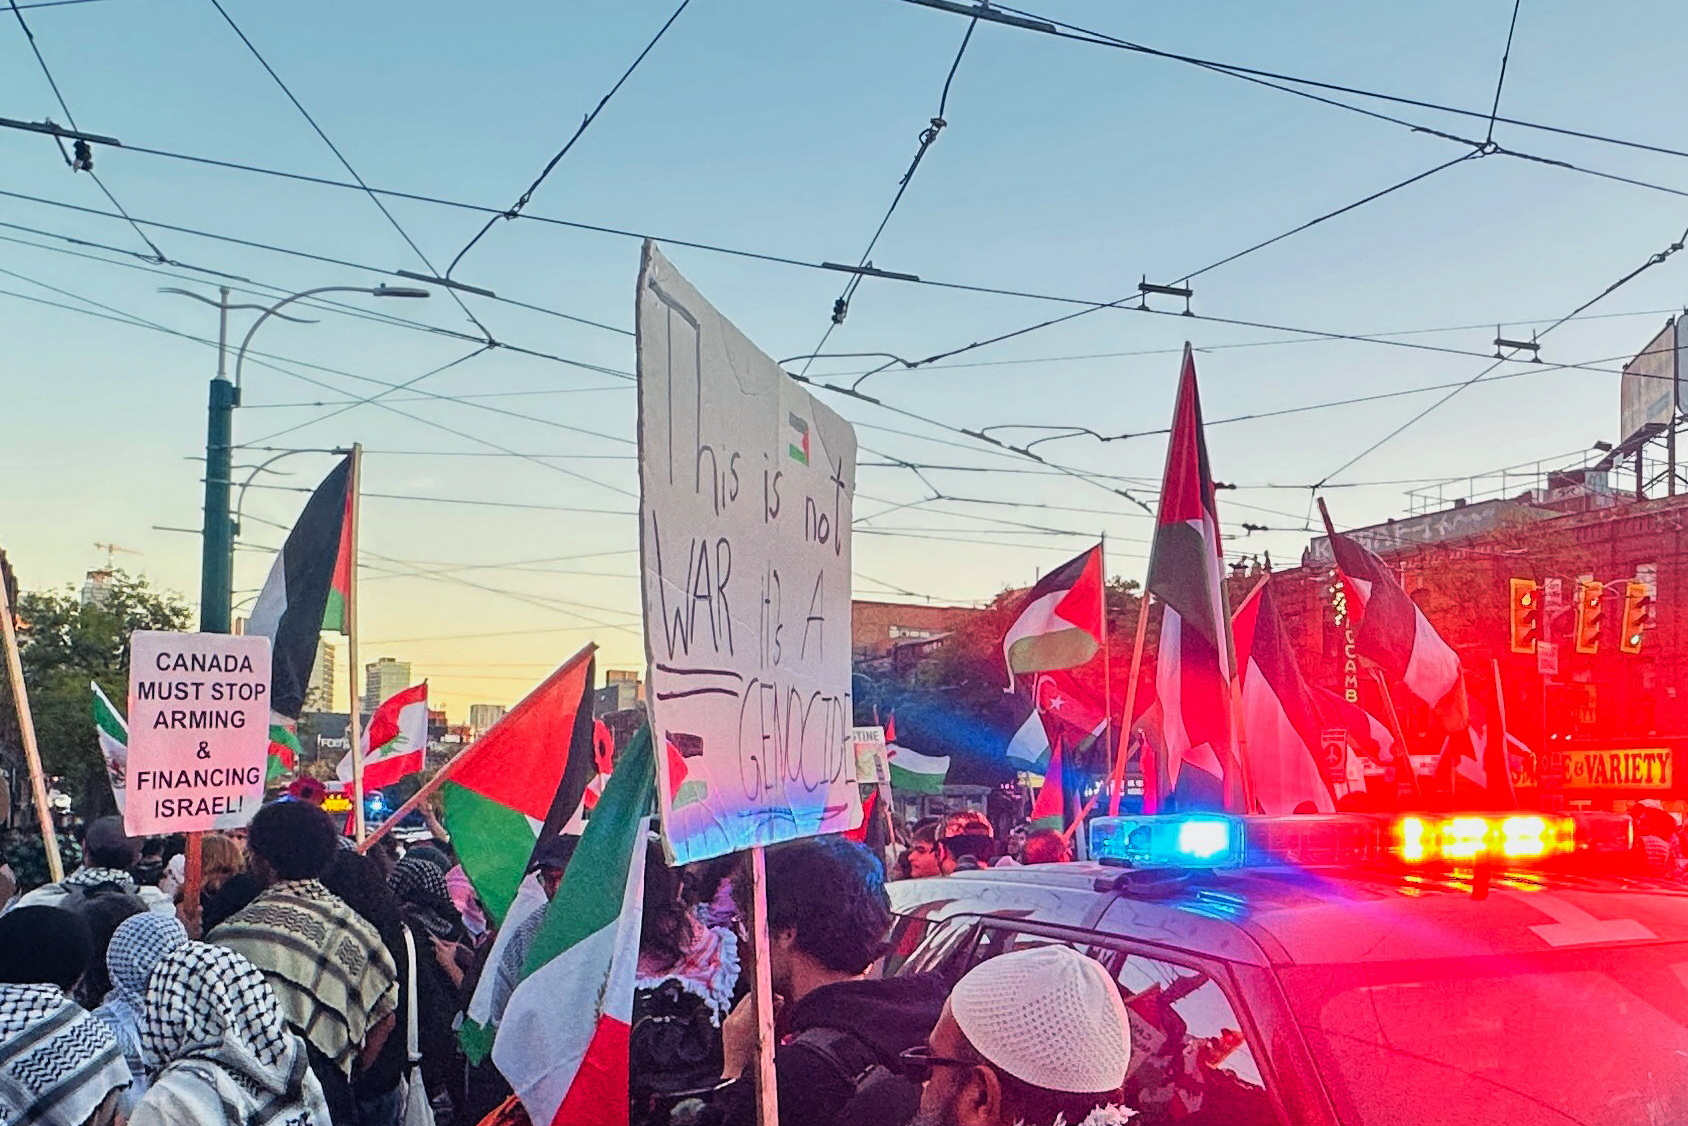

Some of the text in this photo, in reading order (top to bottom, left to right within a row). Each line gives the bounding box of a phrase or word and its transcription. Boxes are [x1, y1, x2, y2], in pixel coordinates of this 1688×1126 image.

[764, 451, 784, 525] is
[805, 455, 846, 557] not
[652, 509, 734, 661] WAR
[800, 569, 825, 663] A
[156, 652, 254, 673] CANADA
[138, 682, 266, 701] MUST STOP
[153, 710, 246, 730] ARMING
[197, 741, 211, 759] &
[738, 677, 856, 802] GENOCIDE
[137, 767, 260, 791] FINANCING
[1584, 752, 1671, 785] VARIETY
[155, 795, 244, 819] ISRAEL!
